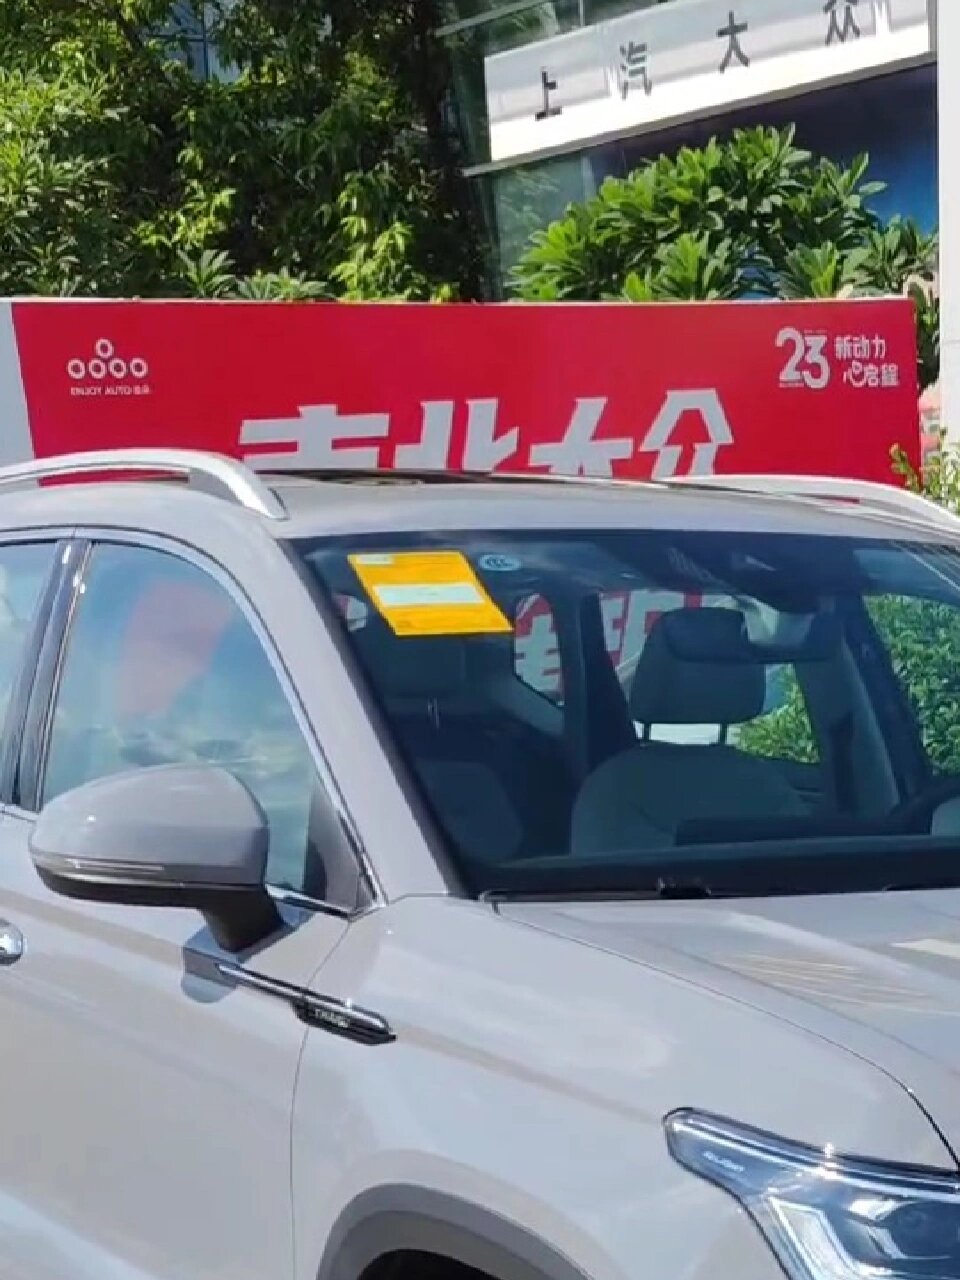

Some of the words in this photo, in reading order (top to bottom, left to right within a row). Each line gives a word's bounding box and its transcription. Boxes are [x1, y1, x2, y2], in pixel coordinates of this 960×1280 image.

[535, 0, 860, 121] 上汽大众
[775, 327, 831, 389] 23
